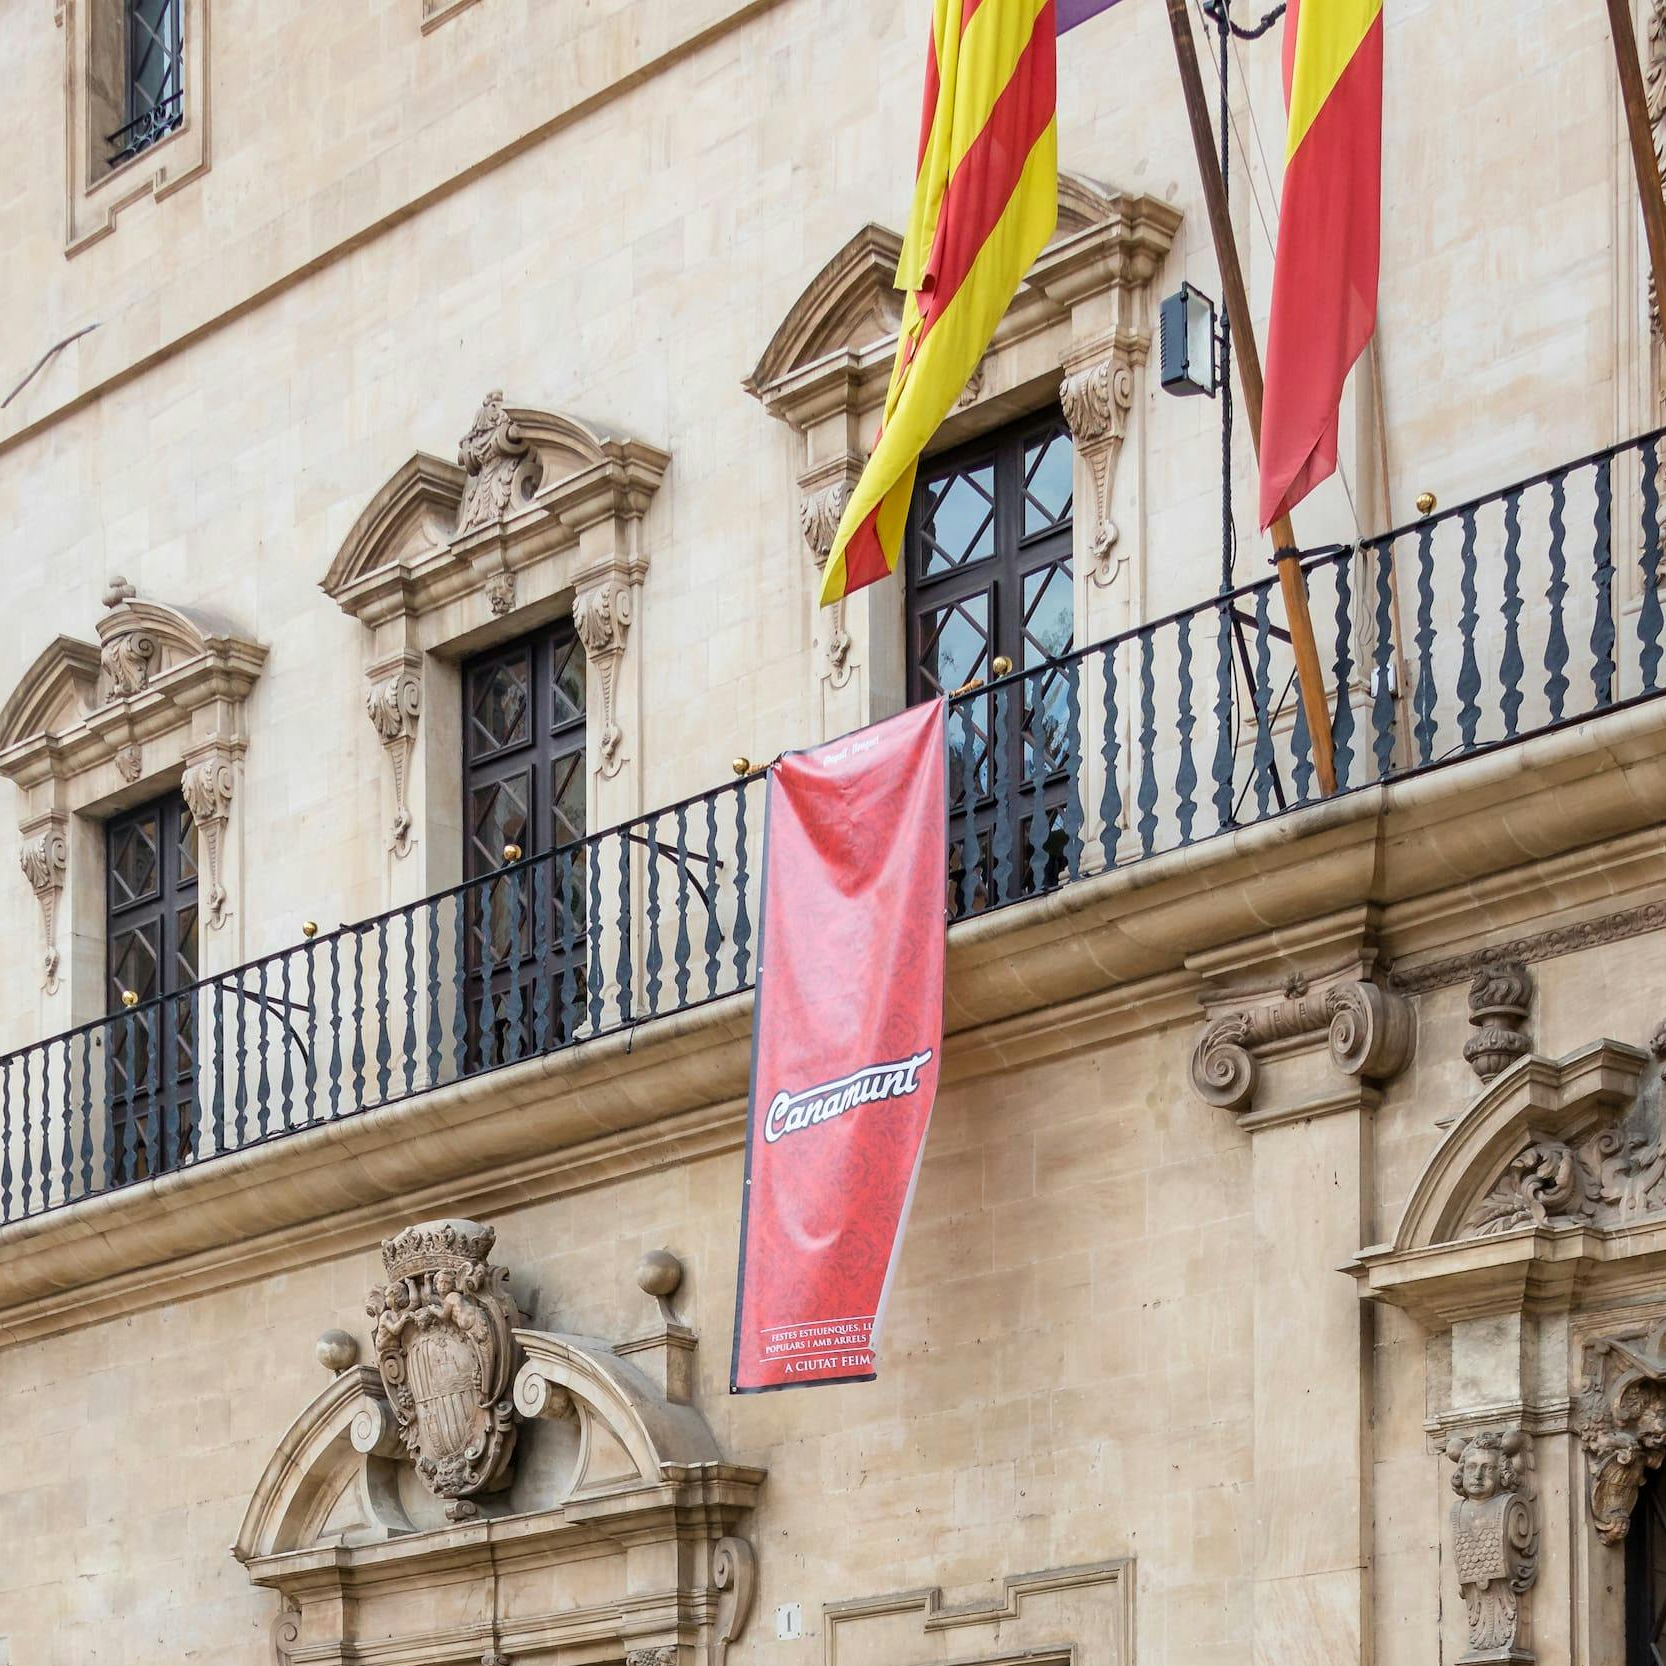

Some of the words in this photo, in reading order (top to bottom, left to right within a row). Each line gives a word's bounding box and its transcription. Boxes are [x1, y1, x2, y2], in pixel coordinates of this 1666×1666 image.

[765, 1050, 932, 1142] Canamunt
[771, 1331, 797, 1342] FESTES
[799, 1323, 861, 1337] ESTIUENQUES,
[765, 1341, 805, 1354] POPULARS
[812, 1338, 832, 1347] AMB
[834, 1334, 867, 1345] ARRELS
[785, 1363, 793, 1373] A
[795, 1357, 838, 1372] CIUTAT
[841, 1355, 871, 1367] FEIM
